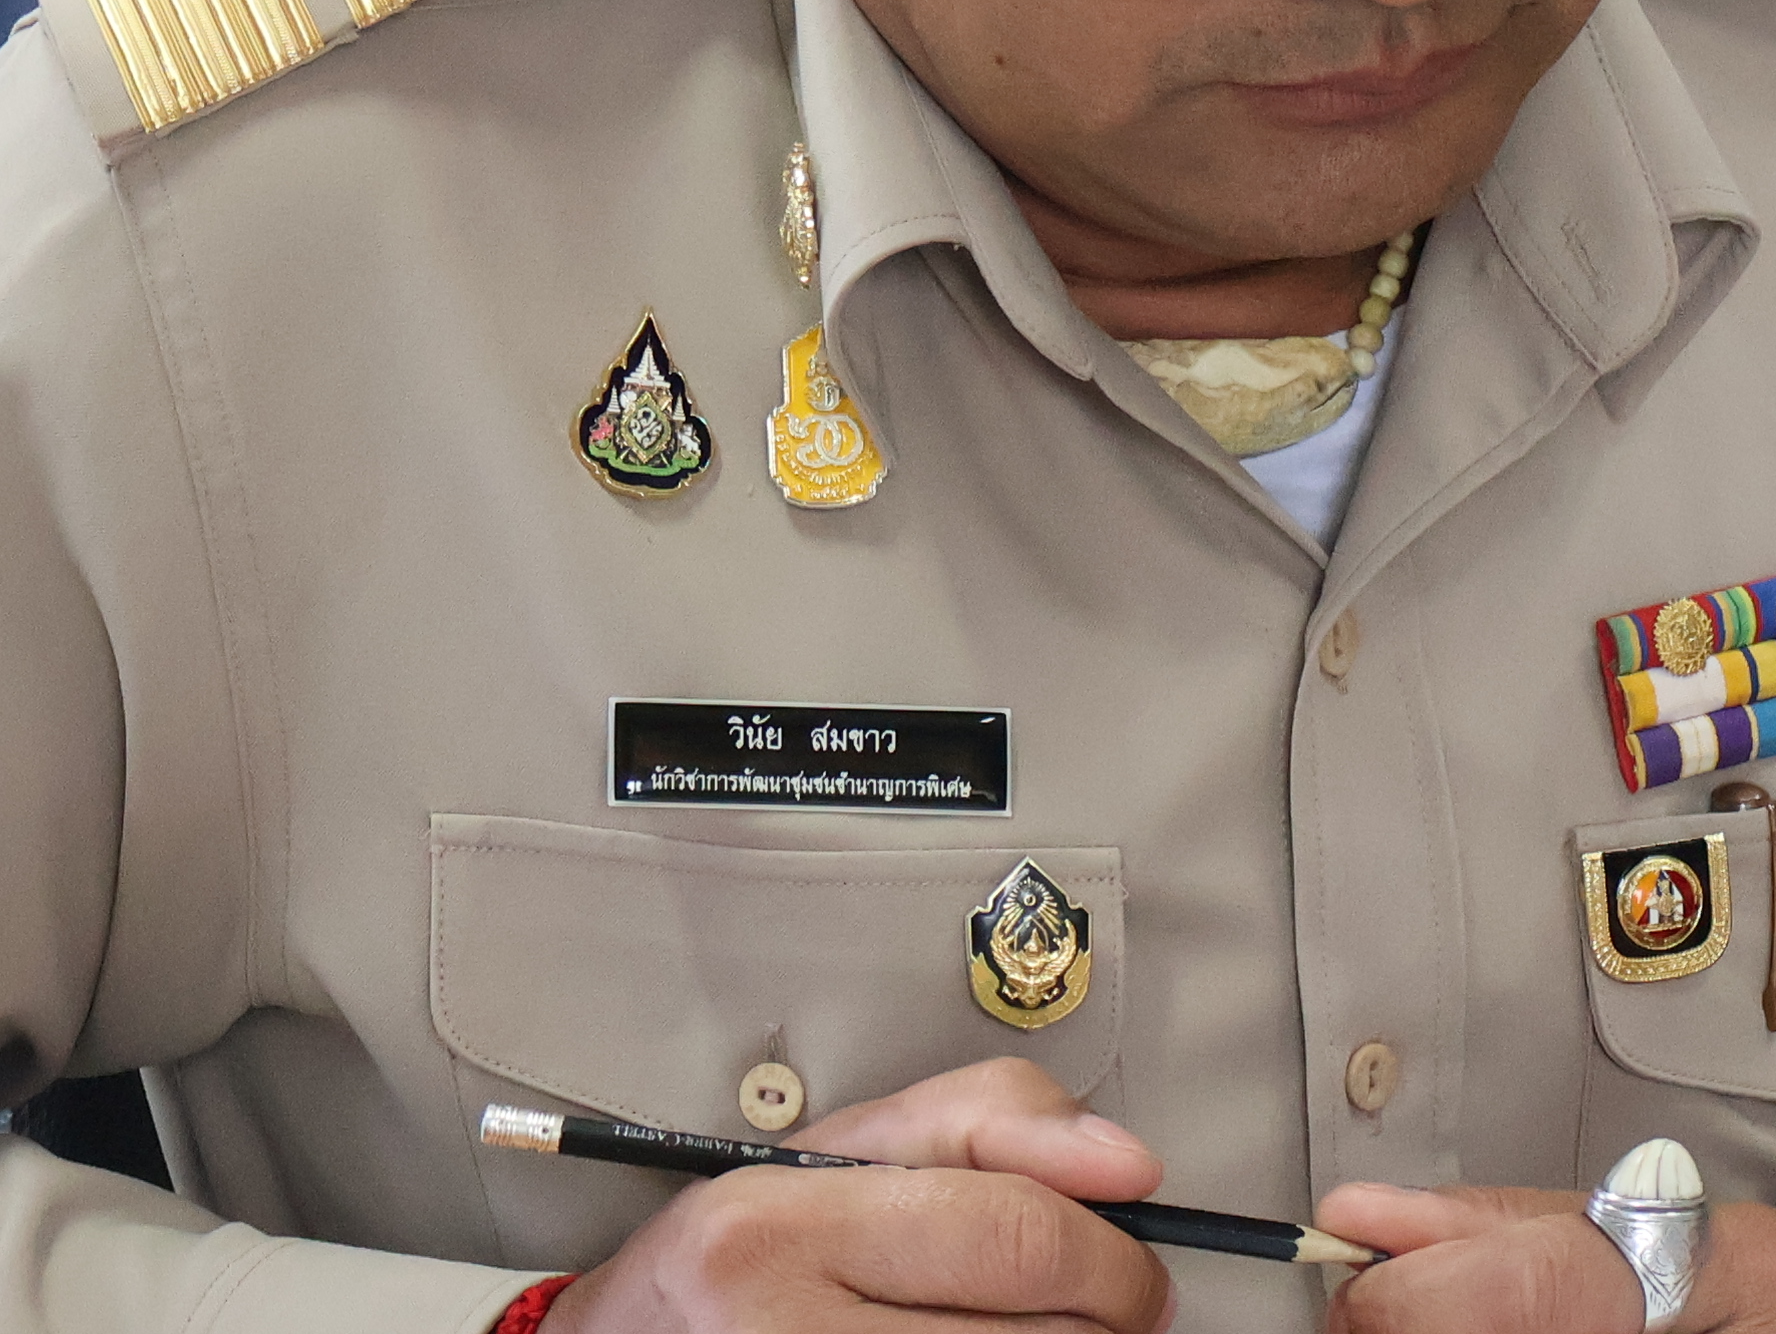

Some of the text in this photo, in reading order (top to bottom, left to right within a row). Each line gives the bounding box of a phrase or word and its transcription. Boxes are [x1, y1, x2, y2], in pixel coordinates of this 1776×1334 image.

[728, 715, 897, 754] วินัย สมขาว
[650, 766, 973, 803] นักวิชาการพัฒนาชุมชนชำนาญการพิเศษ
